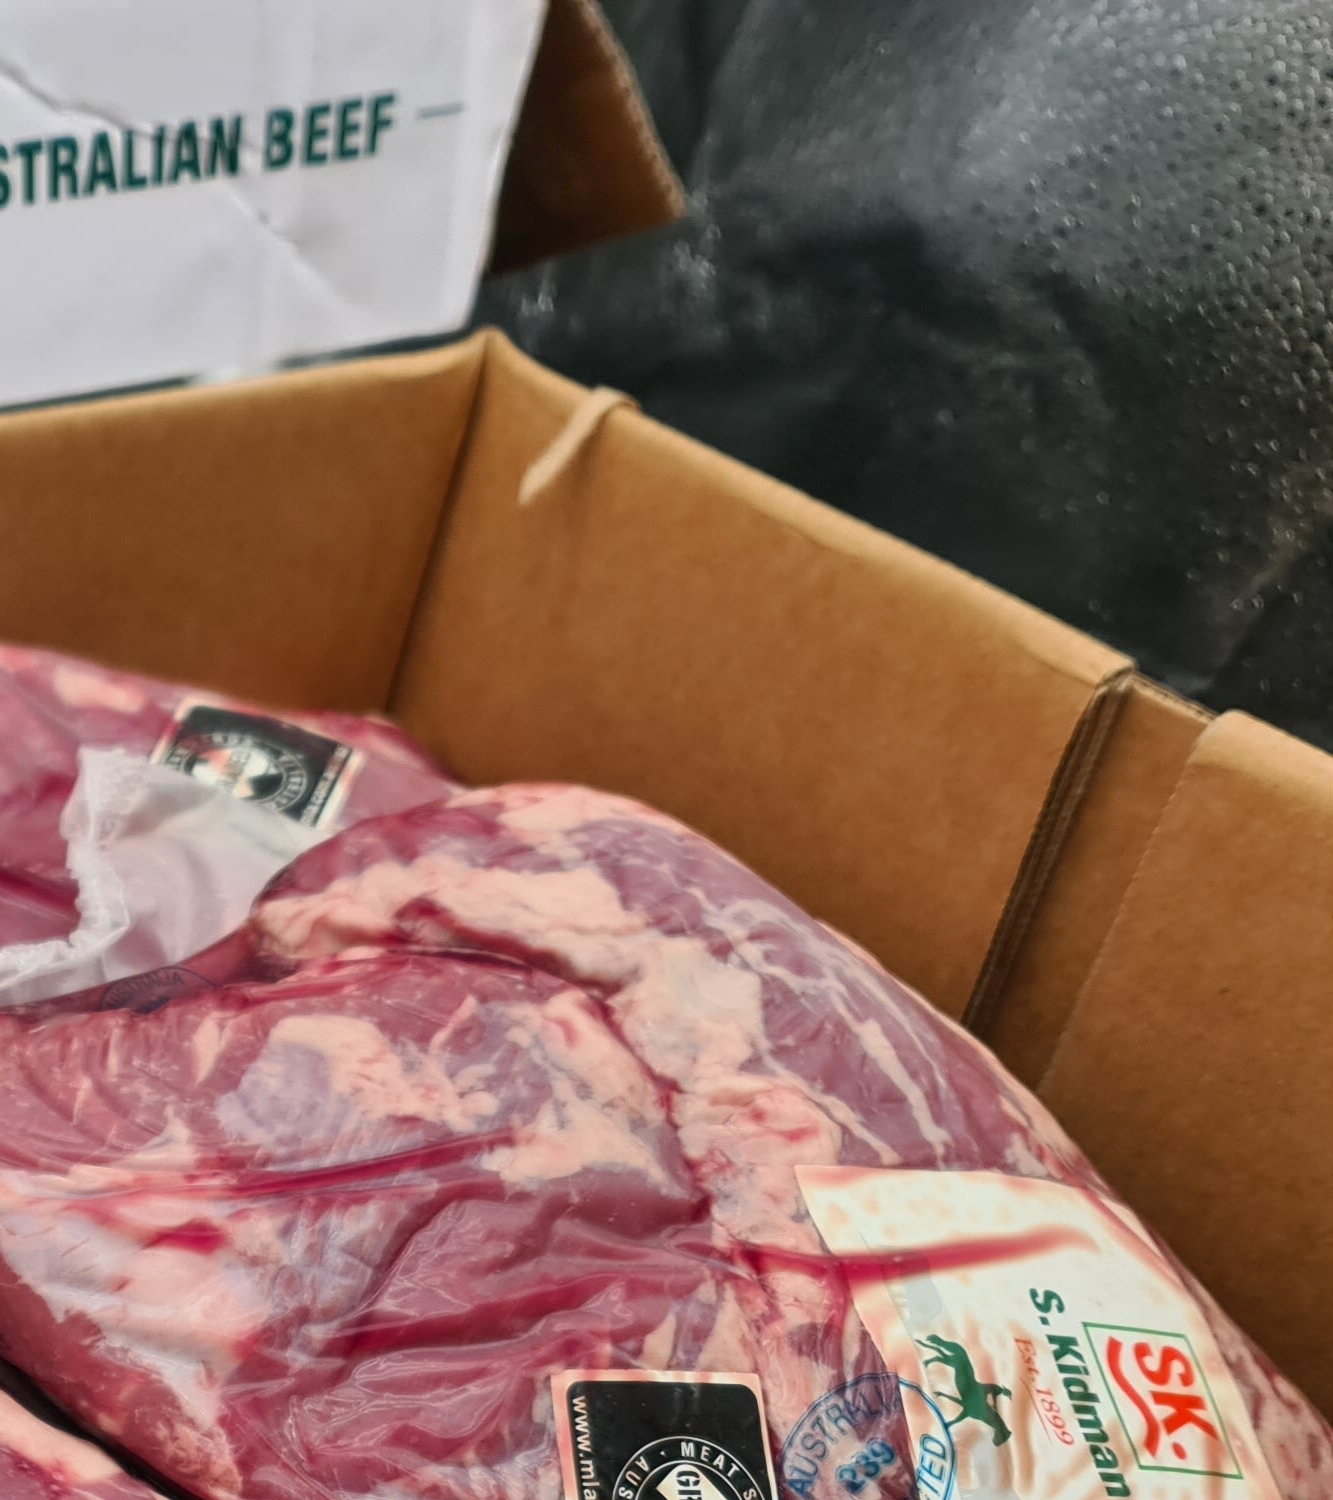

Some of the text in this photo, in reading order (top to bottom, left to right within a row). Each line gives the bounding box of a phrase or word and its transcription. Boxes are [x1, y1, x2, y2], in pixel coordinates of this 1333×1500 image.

[263, 88, 397, 172] BEEF
[1045, 1333, 1132, 1499] Kidman
[680, 1441, 741, 1479] MEAT
[835, 1437, 896, 1494] 239
